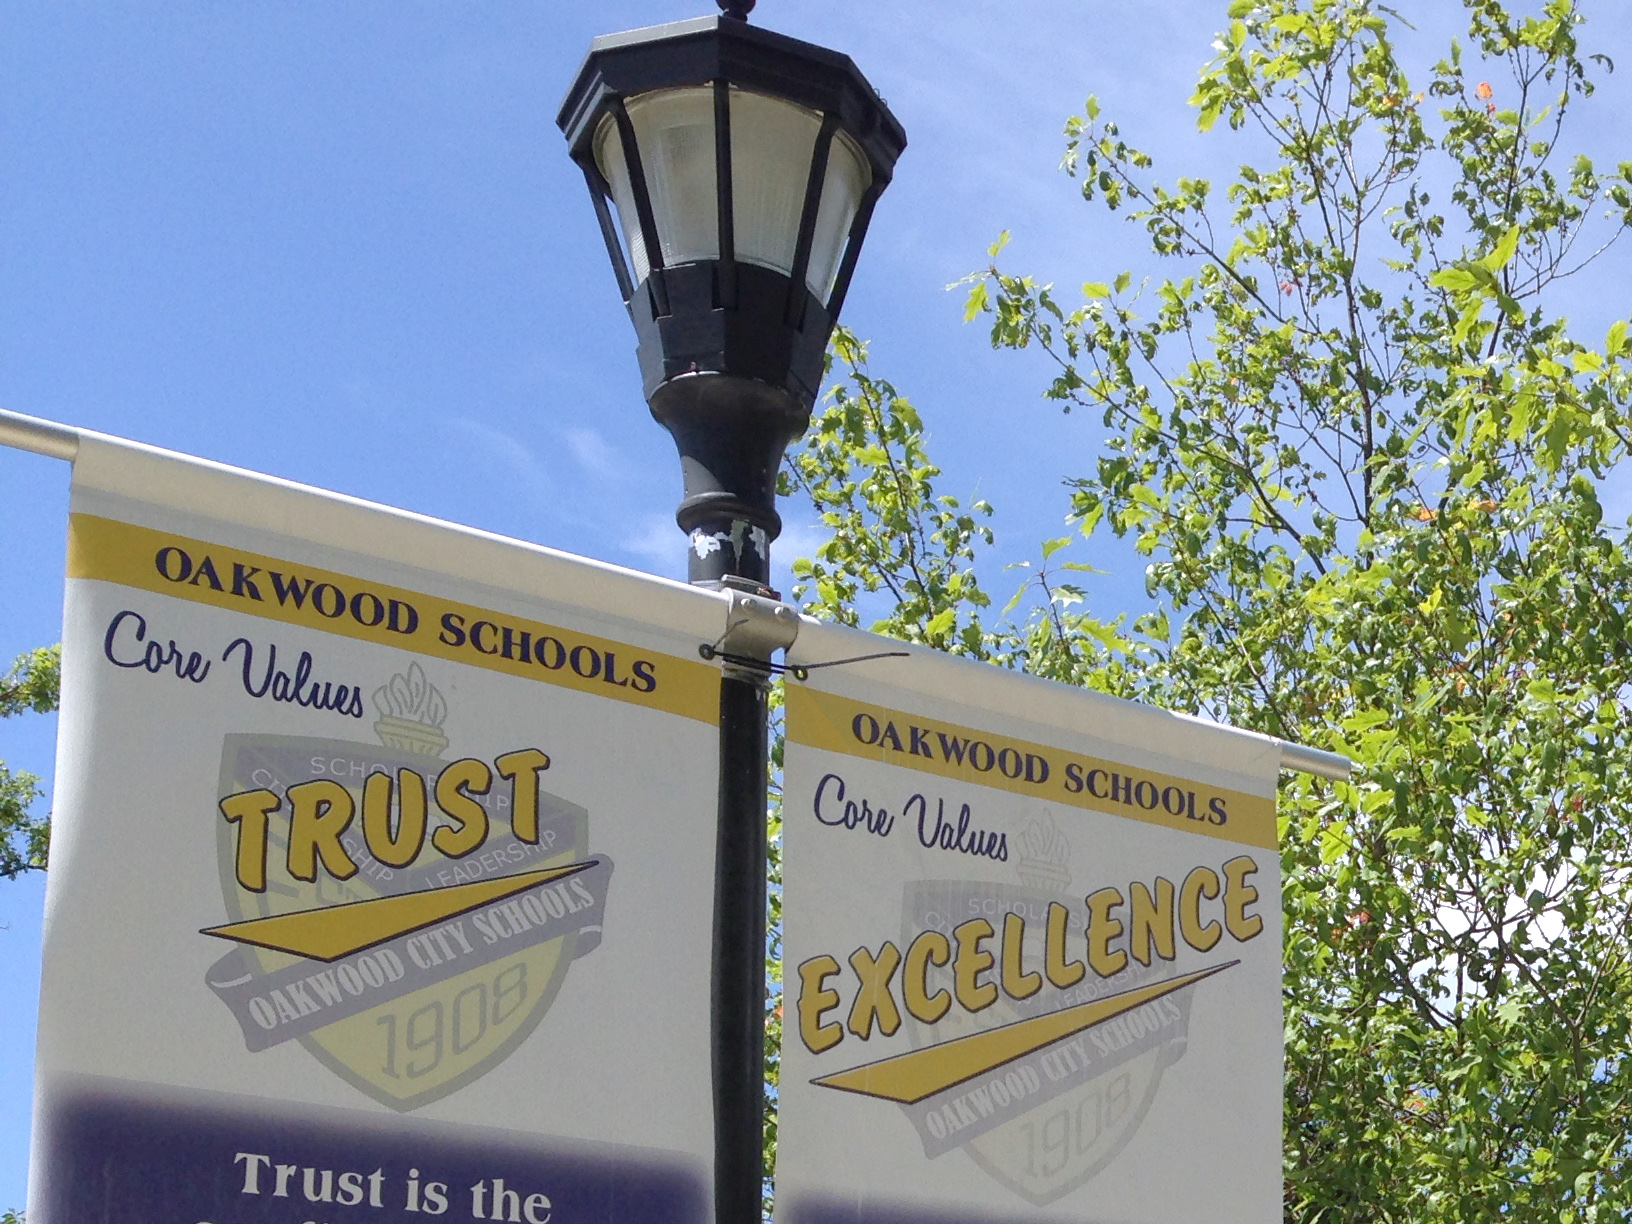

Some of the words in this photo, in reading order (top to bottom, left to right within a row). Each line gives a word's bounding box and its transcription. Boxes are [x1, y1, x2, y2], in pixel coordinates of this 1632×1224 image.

[104, 610, 210, 684] Core
[223, 637, 365, 718] Values
[155, 546, 419, 634] OAKWOOD
[439, 613, 657, 693] SCHOOLS
[219, 748, 550, 893] TRUST
[813, 774, 894, 837] Core
[903, 793, 1008, 862] Values
[852, 712, 1050, 784] OAKWOOD
[1064, 764, 1228, 826] SCHOOLS
[249, 950, 405, 1030] OAKWOOD
[407, 921, 474, 969] CITY
[474, 877, 594, 944] SCHOOLS
[798, 855, 1263, 1055] EXCELLENCE
[377, 962, 528, 1079] 1908
[925, 1065, 1040, 1140] OAKWOOD
[1040, 1042, 1091, 1081] CITY
[1091, 995, 1181, 1057] SCHOOLS
[234, 1152, 385, 1207] Trust
[405, 1168, 448, 1215] is
[1021, 1072, 1131, 1179] 1908
